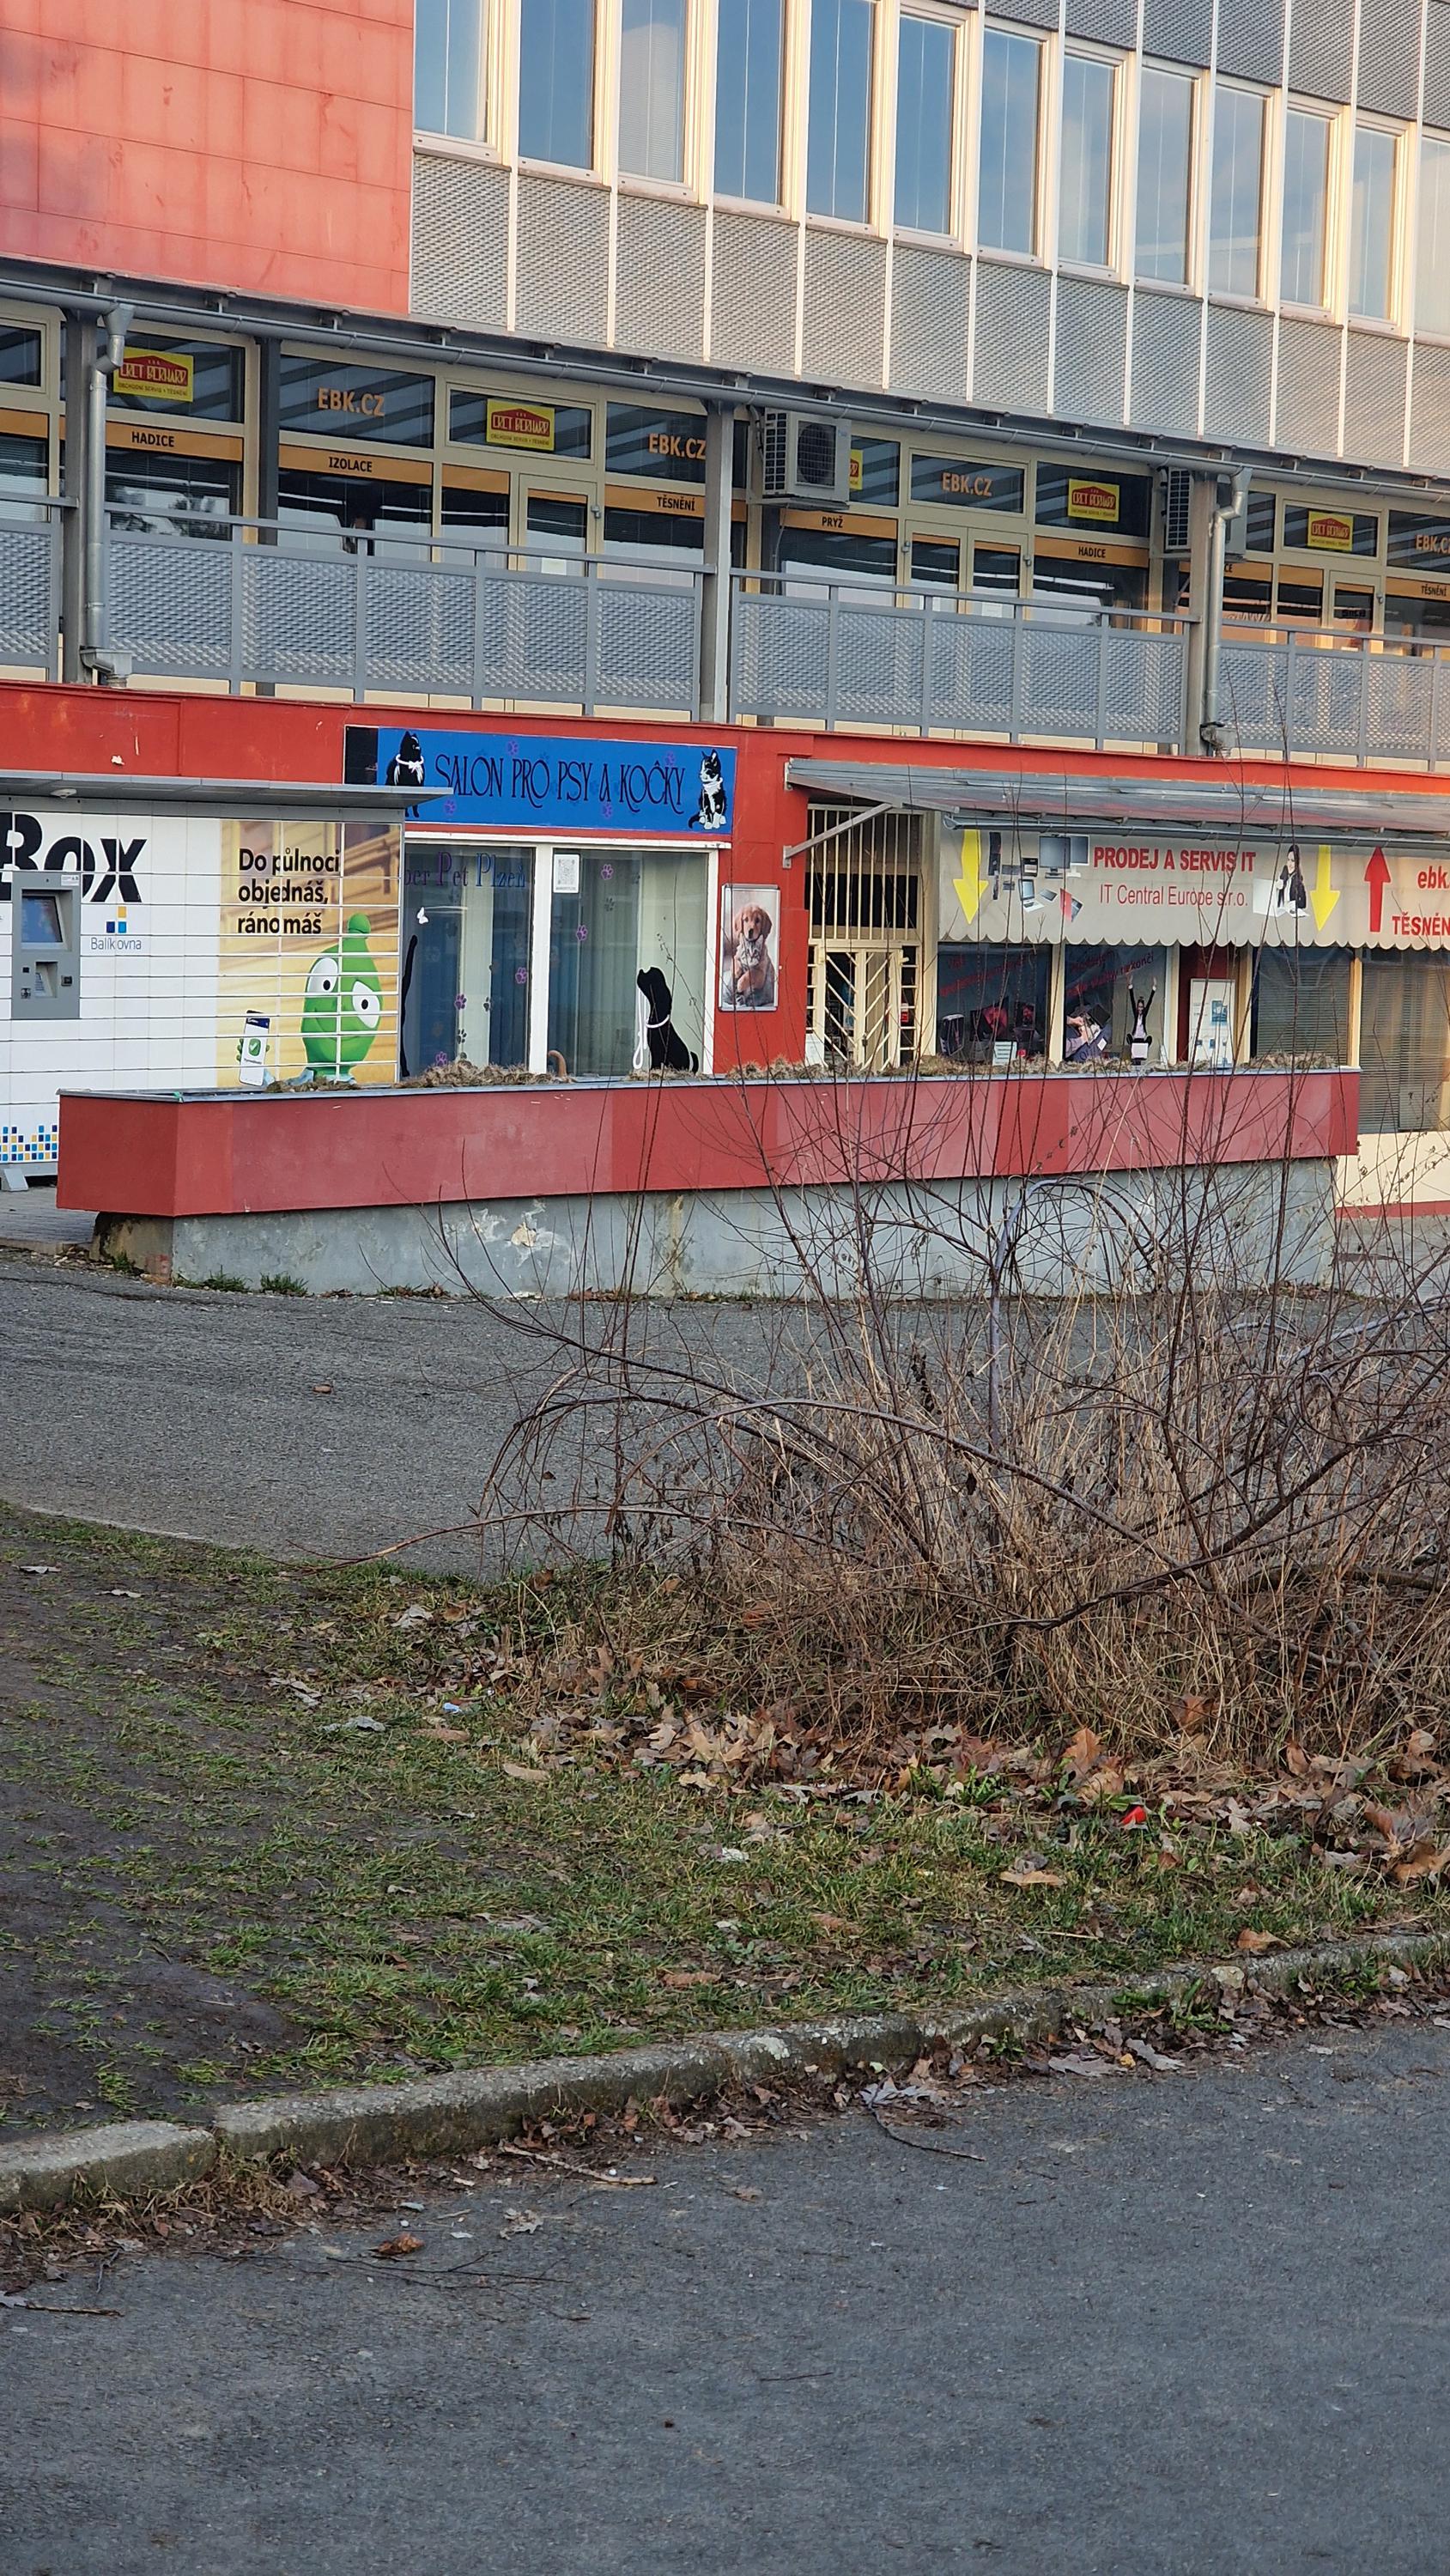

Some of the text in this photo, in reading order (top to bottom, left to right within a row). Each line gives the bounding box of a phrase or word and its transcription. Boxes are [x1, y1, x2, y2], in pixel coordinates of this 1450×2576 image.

[318, 386, 385, 417] EBK.CZ
[131, 430, 175, 448] HADICE
[648, 433, 707, 459] EBK.CZ
[328, 456, 373, 472] IZOLACE
[942, 471, 992, 496] EBK.CZ
[657, 494, 695, 512] TĚSNĚNÍ
[821, 514, 844, 529] PRYŽ
[1078, 546, 1107, 559] HADICE
[435, 754, 504, 797] SALON
[512, 758, 550, 808] PRO
[557, 761, 593, 801] PSY
[239, 847, 340, 876] Do půlnoci
[1094, 847, 1257, 872] PRODEJ A SERVIS IT
[238, 878, 329, 909] objednáš,
[1100, 884, 1248, 908] IT Central Europe s.r.o.
[238, 911, 322, 934] ráno máš
